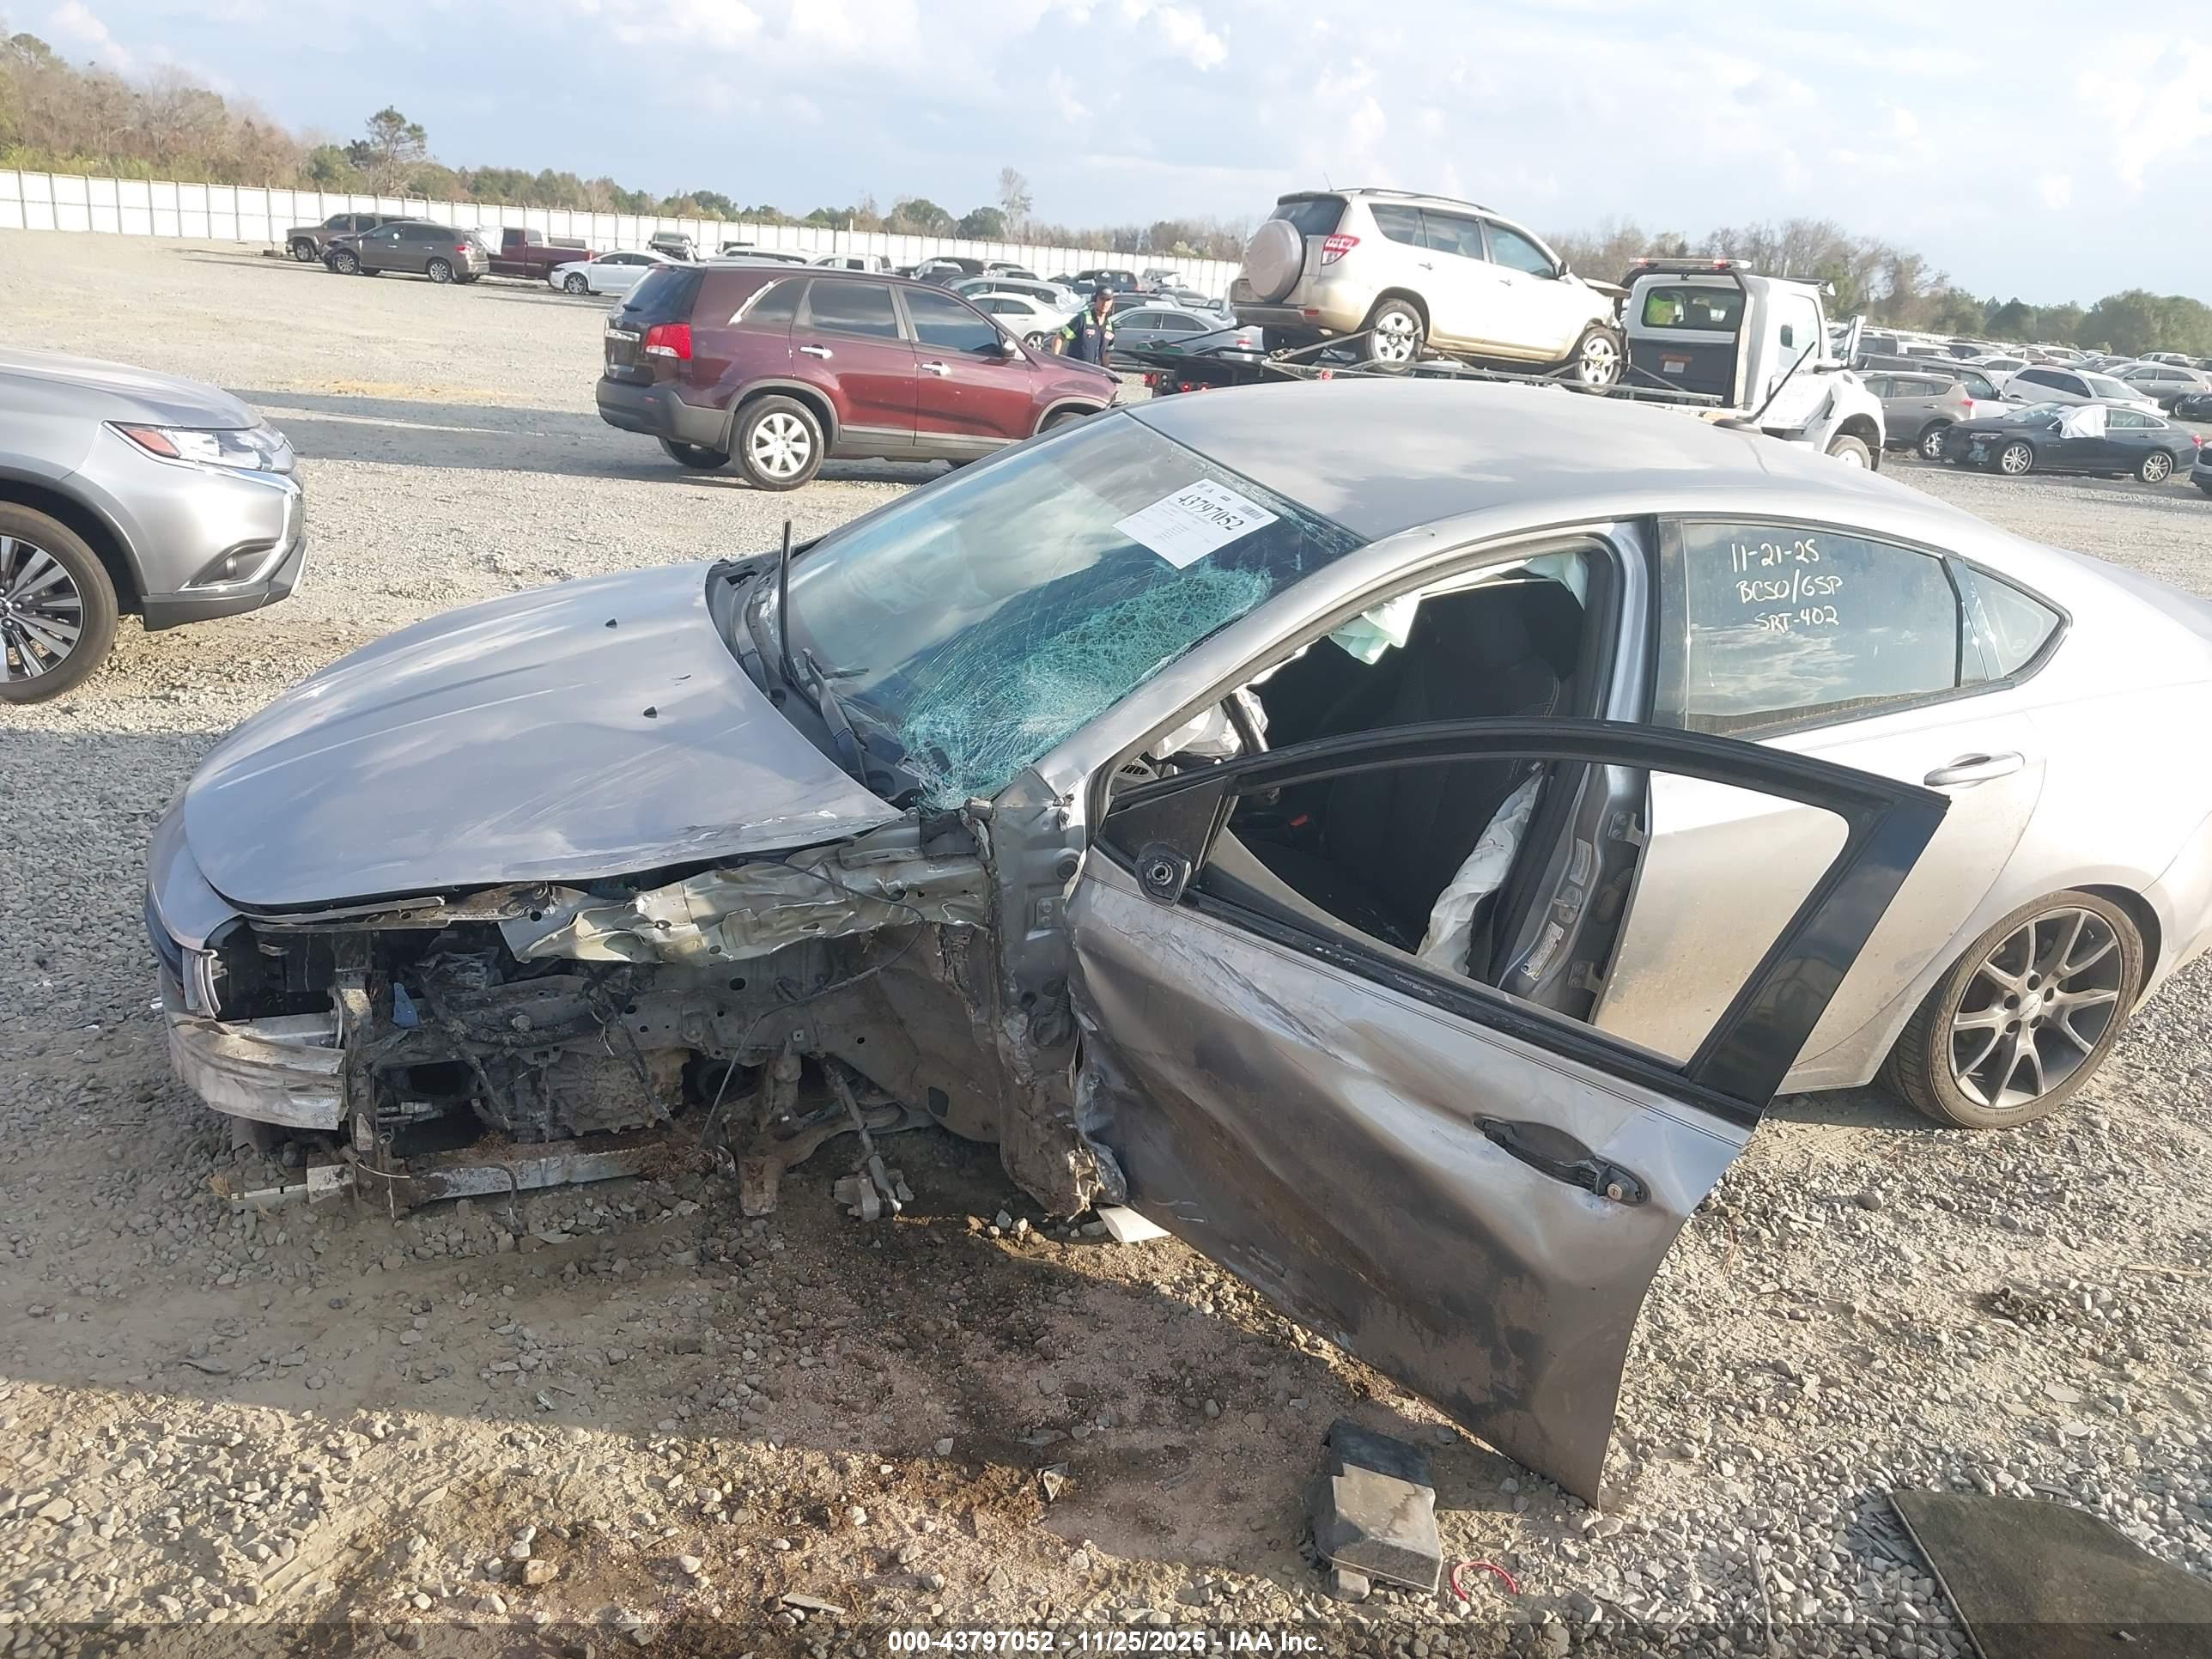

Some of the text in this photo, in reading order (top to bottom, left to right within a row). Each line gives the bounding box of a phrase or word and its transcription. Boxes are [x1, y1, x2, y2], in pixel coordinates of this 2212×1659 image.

[1177, 494, 1245, 531] 43797052
[1731, 538, 1820, 574] 11-21-25
[1754, 605, 1840, 634] SRT-402
